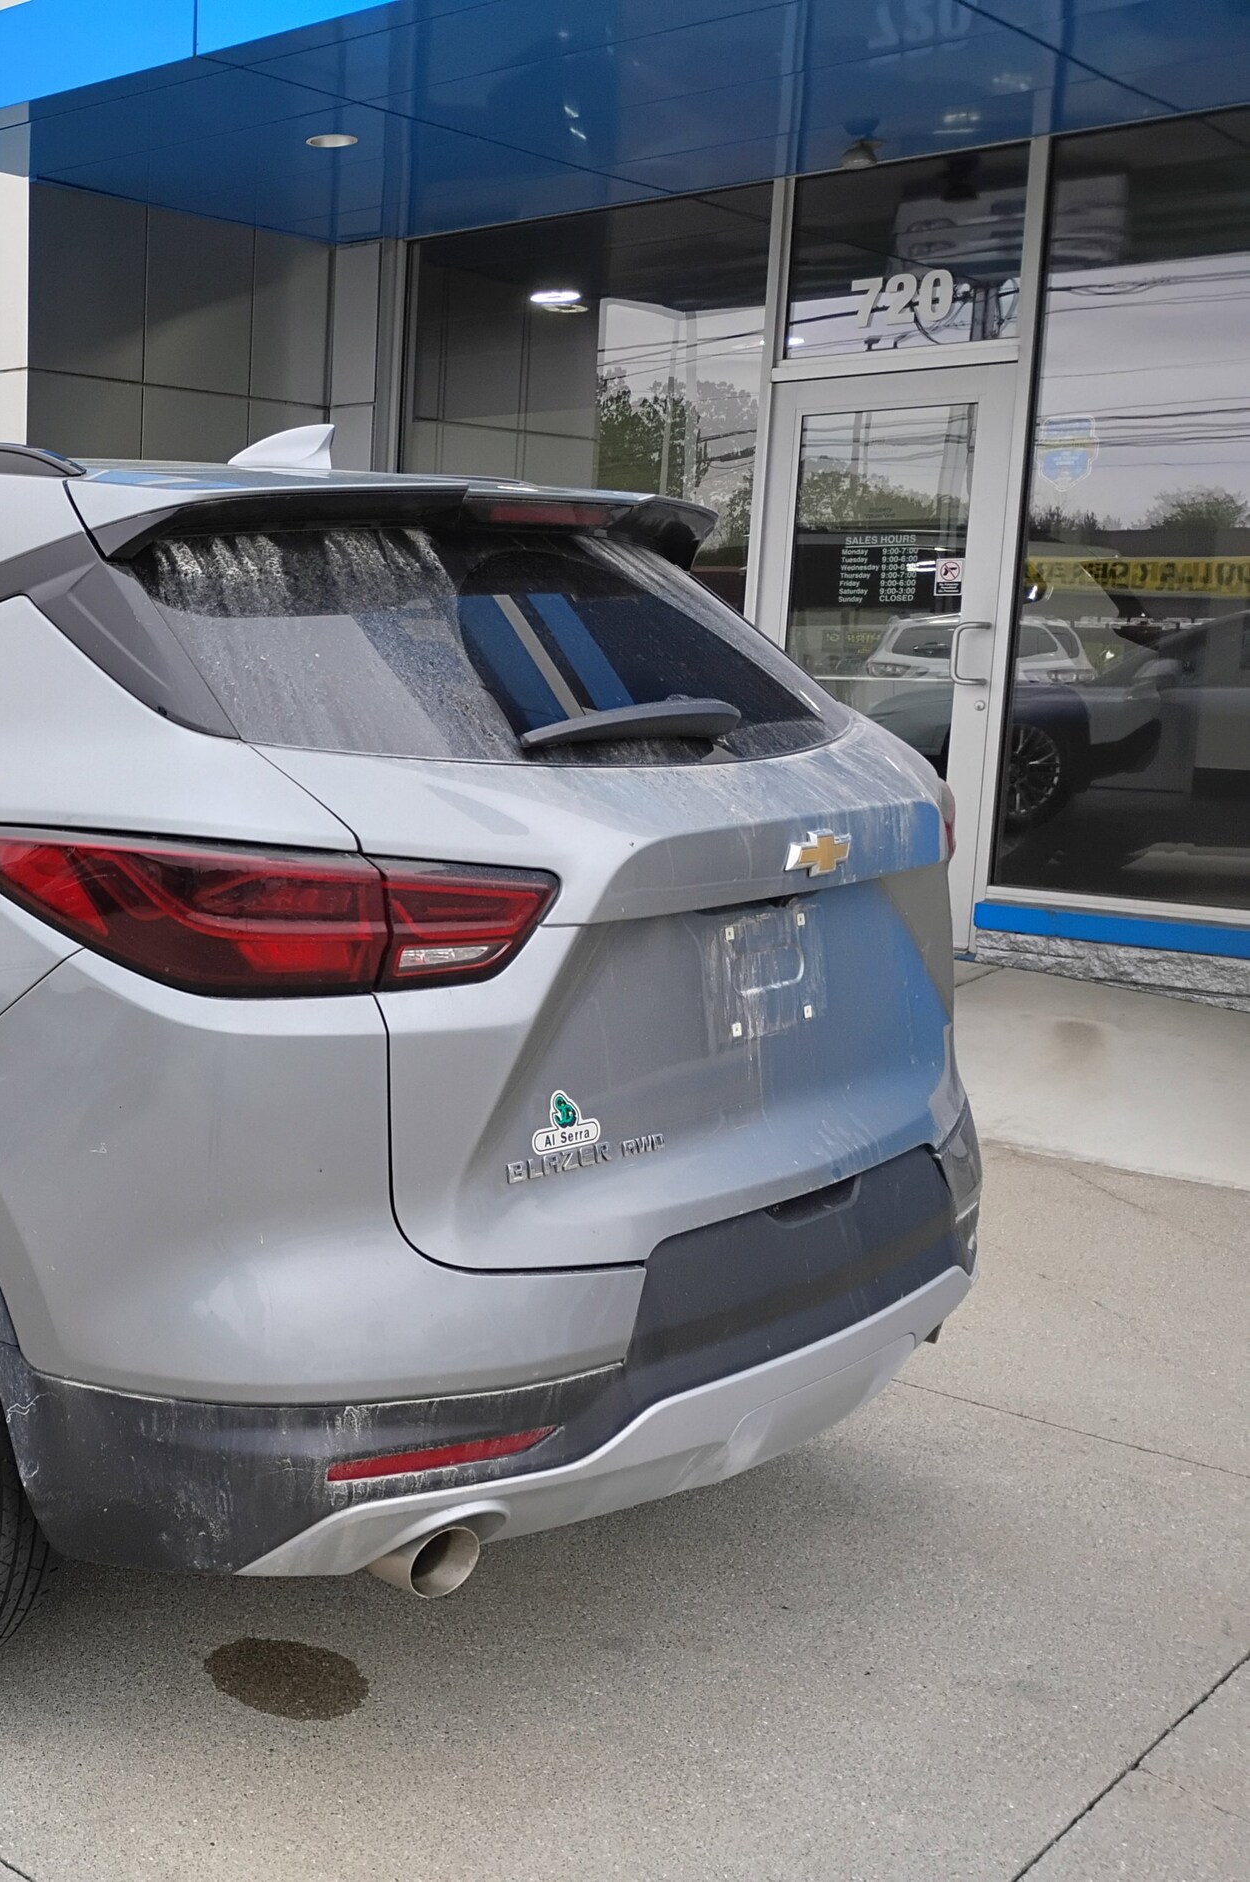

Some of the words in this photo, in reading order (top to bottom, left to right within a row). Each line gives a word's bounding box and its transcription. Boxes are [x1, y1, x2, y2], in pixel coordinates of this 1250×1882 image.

[851, 269, 954, 329] 720
[845, 536, 878, 545] SALES
[880, 535, 917, 544] HOURS
[882, 547, 918, 555] 9:00-7:00
[841, 556, 868, 564] Tuesday
[881, 555, 918, 563] 9:00-6:00
[840, 564, 880, 572] Wednesday
[840, 572, 871, 580] Thursday
[880, 571, 917, 579] 9:00-7:00
[839, 580, 860, 588] Friday
[880, 579, 916, 587] 9:00-6:00
[838, 588, 868, 596] Saturday
[879, 587, 916, 595] 9:00-3:00
[838, 596, 863, 604] Sunday
[879, 594, 914, 602] CLOSED
[544, 1136, 556, 1148] Al
[561, 1128, 590, 1144] Serra
[506, 1141, 612, 1184] BLAZER
